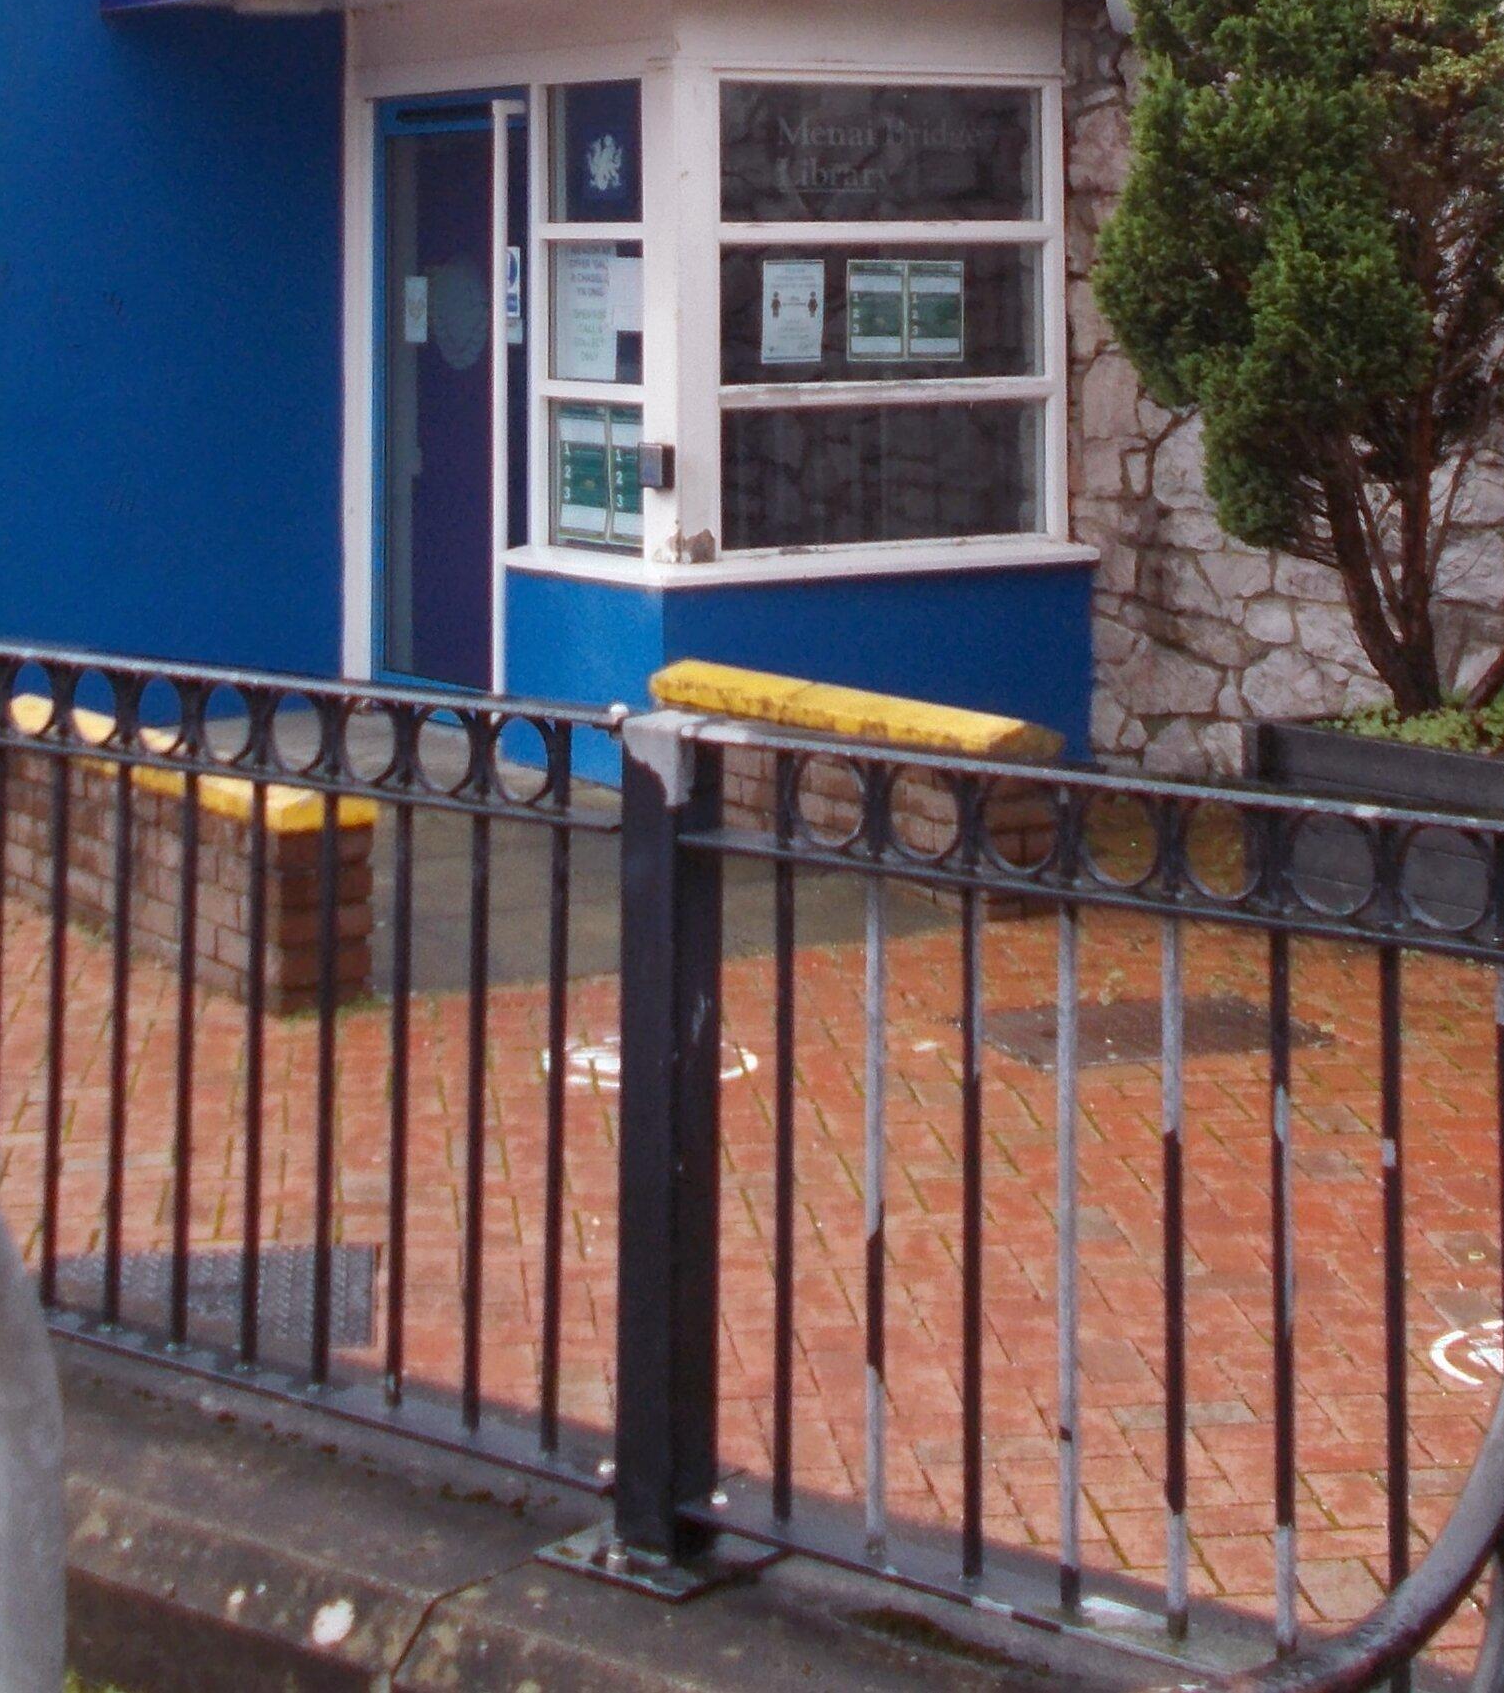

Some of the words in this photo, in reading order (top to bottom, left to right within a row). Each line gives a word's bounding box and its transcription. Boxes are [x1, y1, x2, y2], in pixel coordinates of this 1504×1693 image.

[777, 115, 876, 147] Menai
[615, 448, 623, 462] 1
[563, 464, 572, 479] 2
[615, 470, 623, 485] 2
[563, 485, 571, 499] 3
[616, 493, 624, 508] 3
